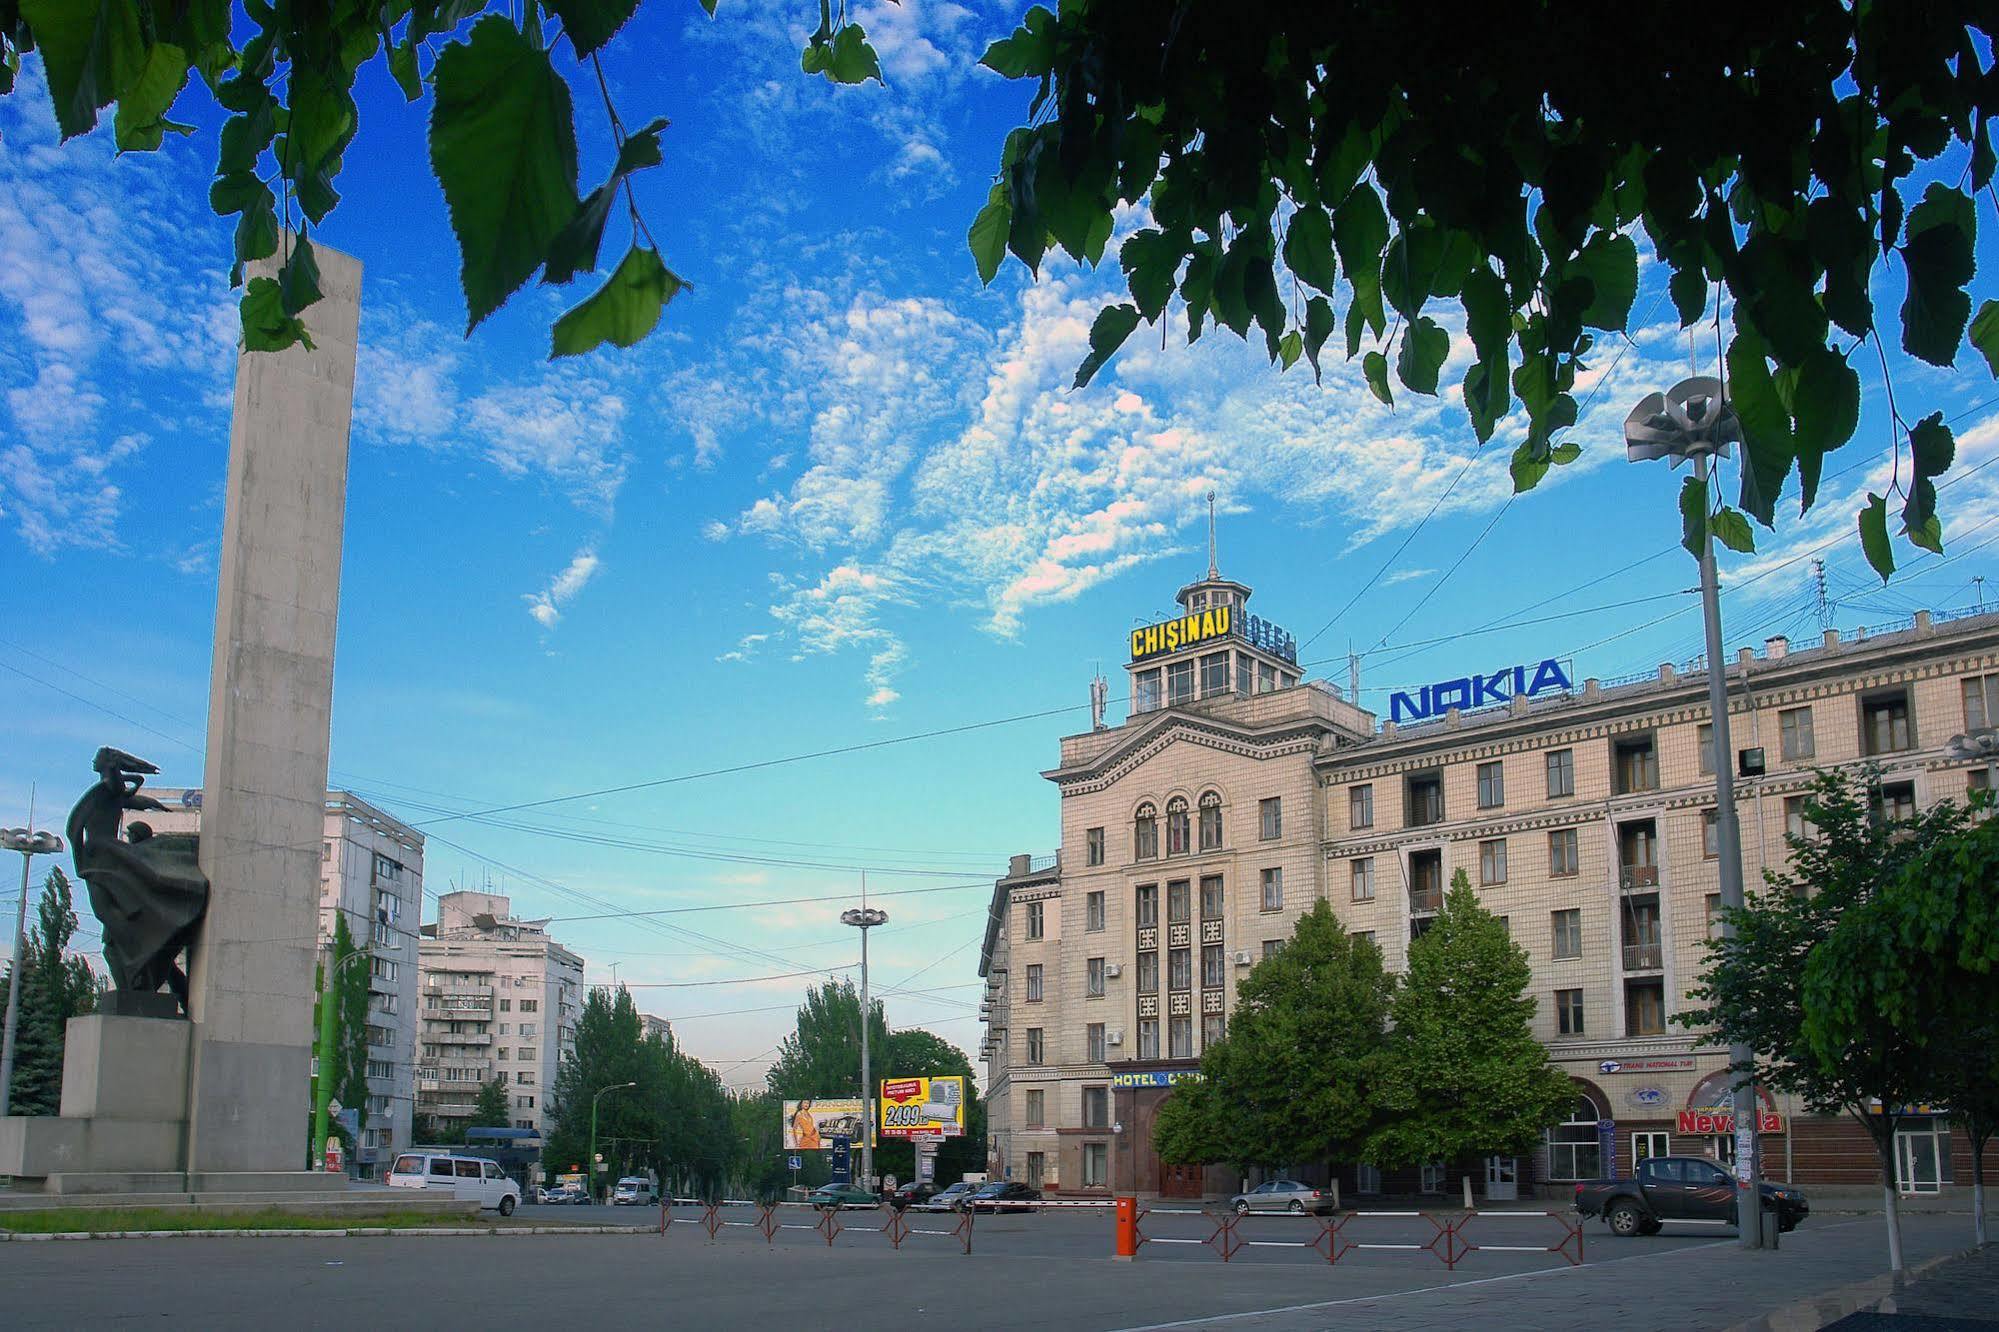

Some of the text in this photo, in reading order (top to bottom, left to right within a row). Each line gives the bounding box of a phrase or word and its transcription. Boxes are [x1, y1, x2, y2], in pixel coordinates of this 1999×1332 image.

[1237, 607, 1295, 661] HOTEL
[1390, 658, 1571, 723] NOKIA
[1113, 1074, 1157, 1087] HOTEL
[885, 1105, 920, 1127] 2499
[1679, 1109, 1782, 1133] Neva
